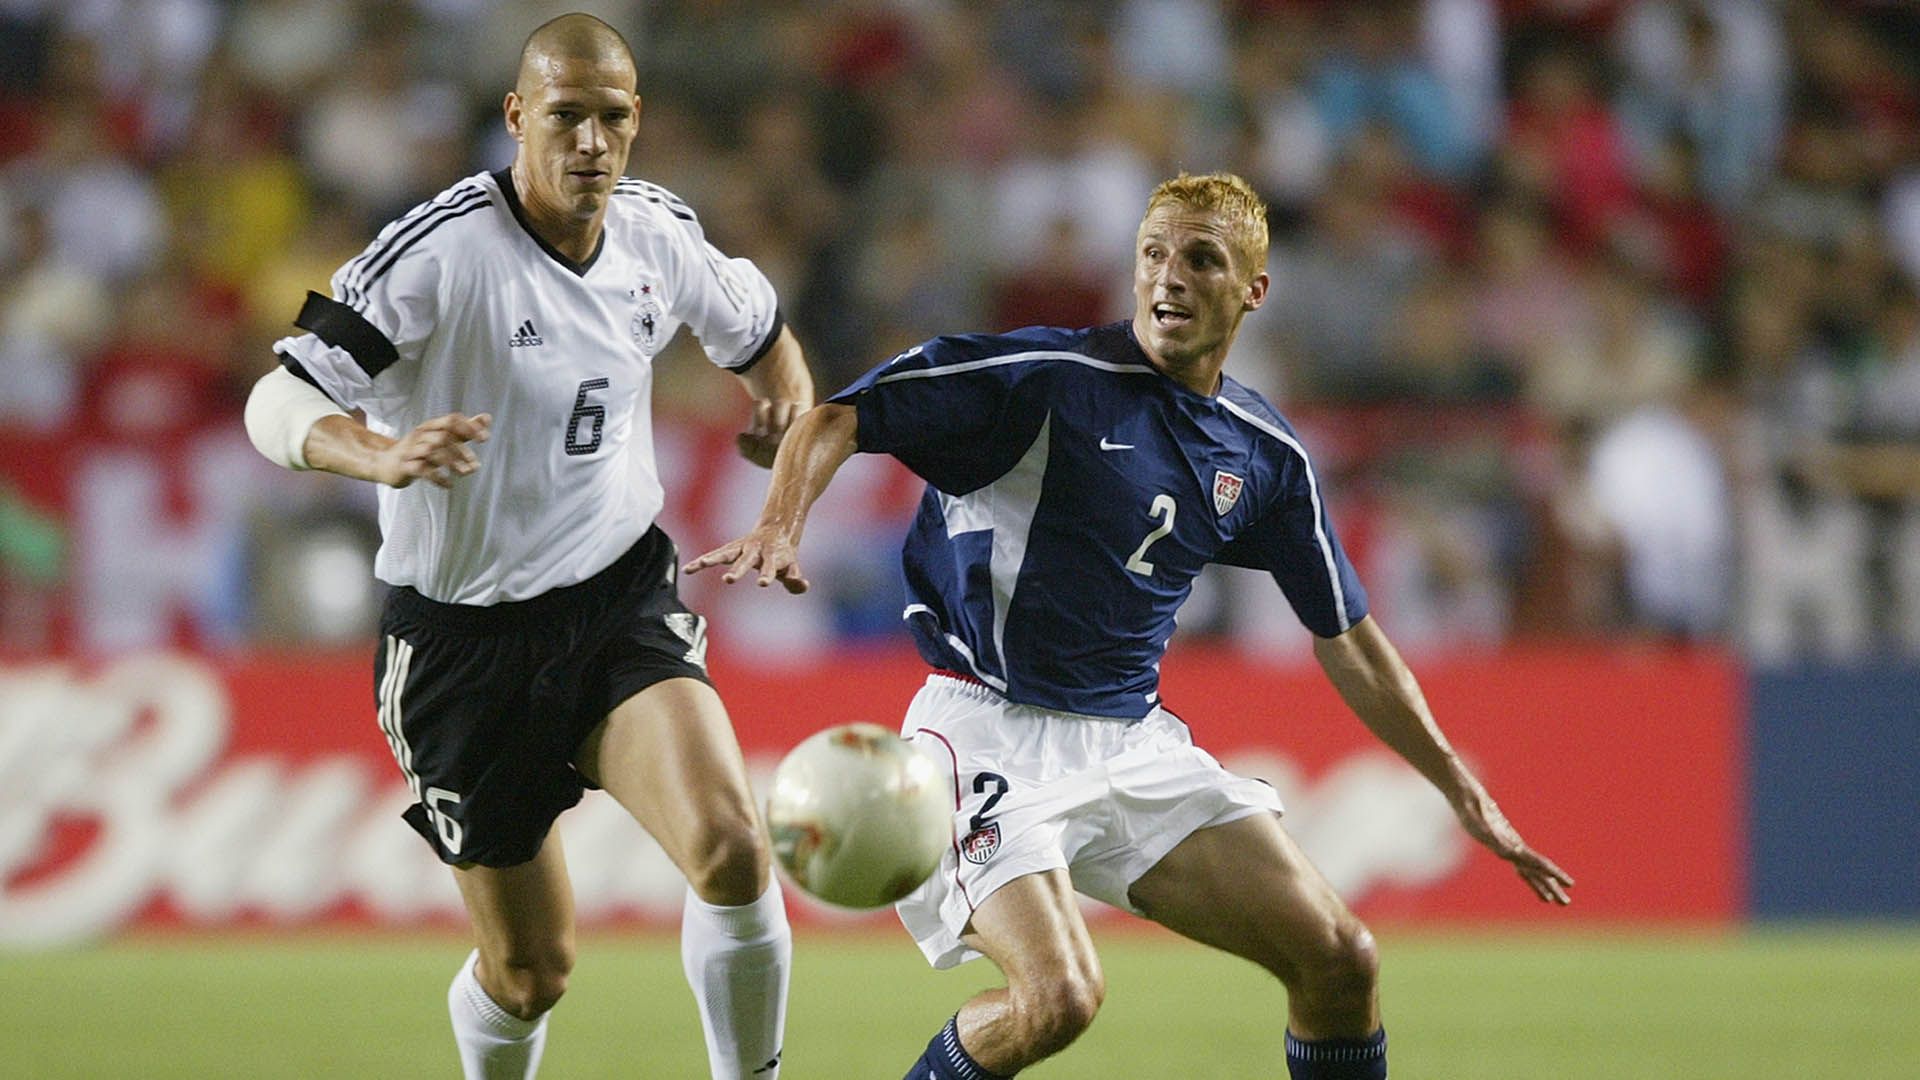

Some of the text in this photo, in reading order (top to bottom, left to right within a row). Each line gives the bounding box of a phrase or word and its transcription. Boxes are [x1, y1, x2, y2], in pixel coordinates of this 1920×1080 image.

[509, 337, 544, 348] adidas
[565, 378, 609, 456] 6
[1125, 494, 1176, 577] 2
[426, 786, 463, 855] 6
[969, 771, 1009, 832] 2
